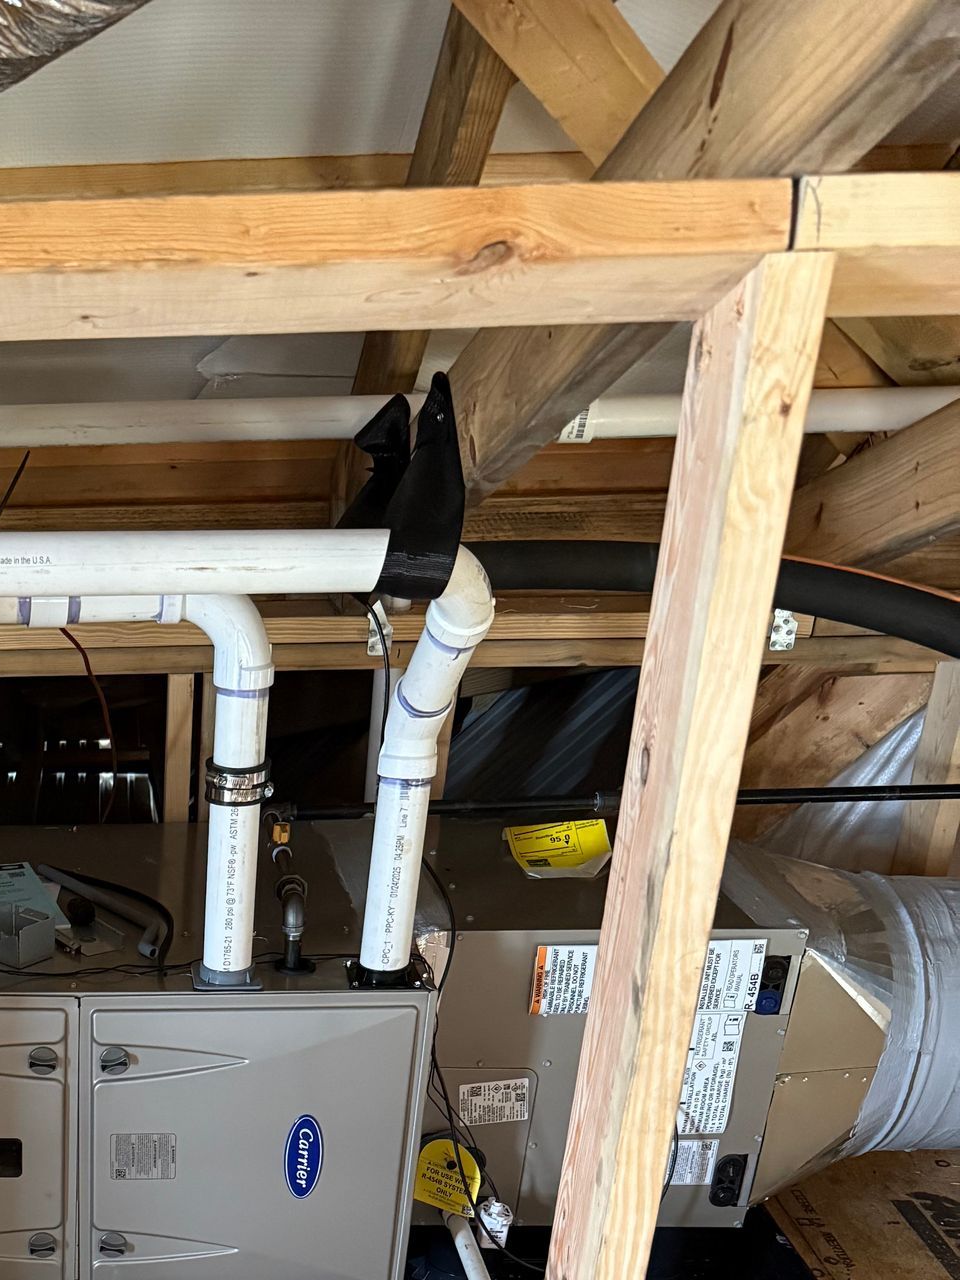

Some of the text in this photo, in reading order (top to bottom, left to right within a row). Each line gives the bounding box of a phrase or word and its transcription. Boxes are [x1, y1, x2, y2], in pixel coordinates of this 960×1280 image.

[20, 556, 31, 565] the
[230, 818, 239, 841] ASTM
[390, 866, 402, 899] 01/24/2025
[226, 906, 236, 917] psi
[225, 917, 234, 930] 280
[535, 972, 543, 998] WARNING
[747, 974, 759, 998] 454B
[714, 1080, 724, 1104] CHARGE
[721, 1079, 731, 1103] CHARGE
[711, 1105, 720, 1121] TOTAL
[718, 1104, 727, 1121] TOTAL
[296, 1128, 313, 1187] Carrier
[426, 1166, 440, 1177] FOR
[440, 1170, 454, 1181] USE
[436, 1187, 452, 1198] ONLY
